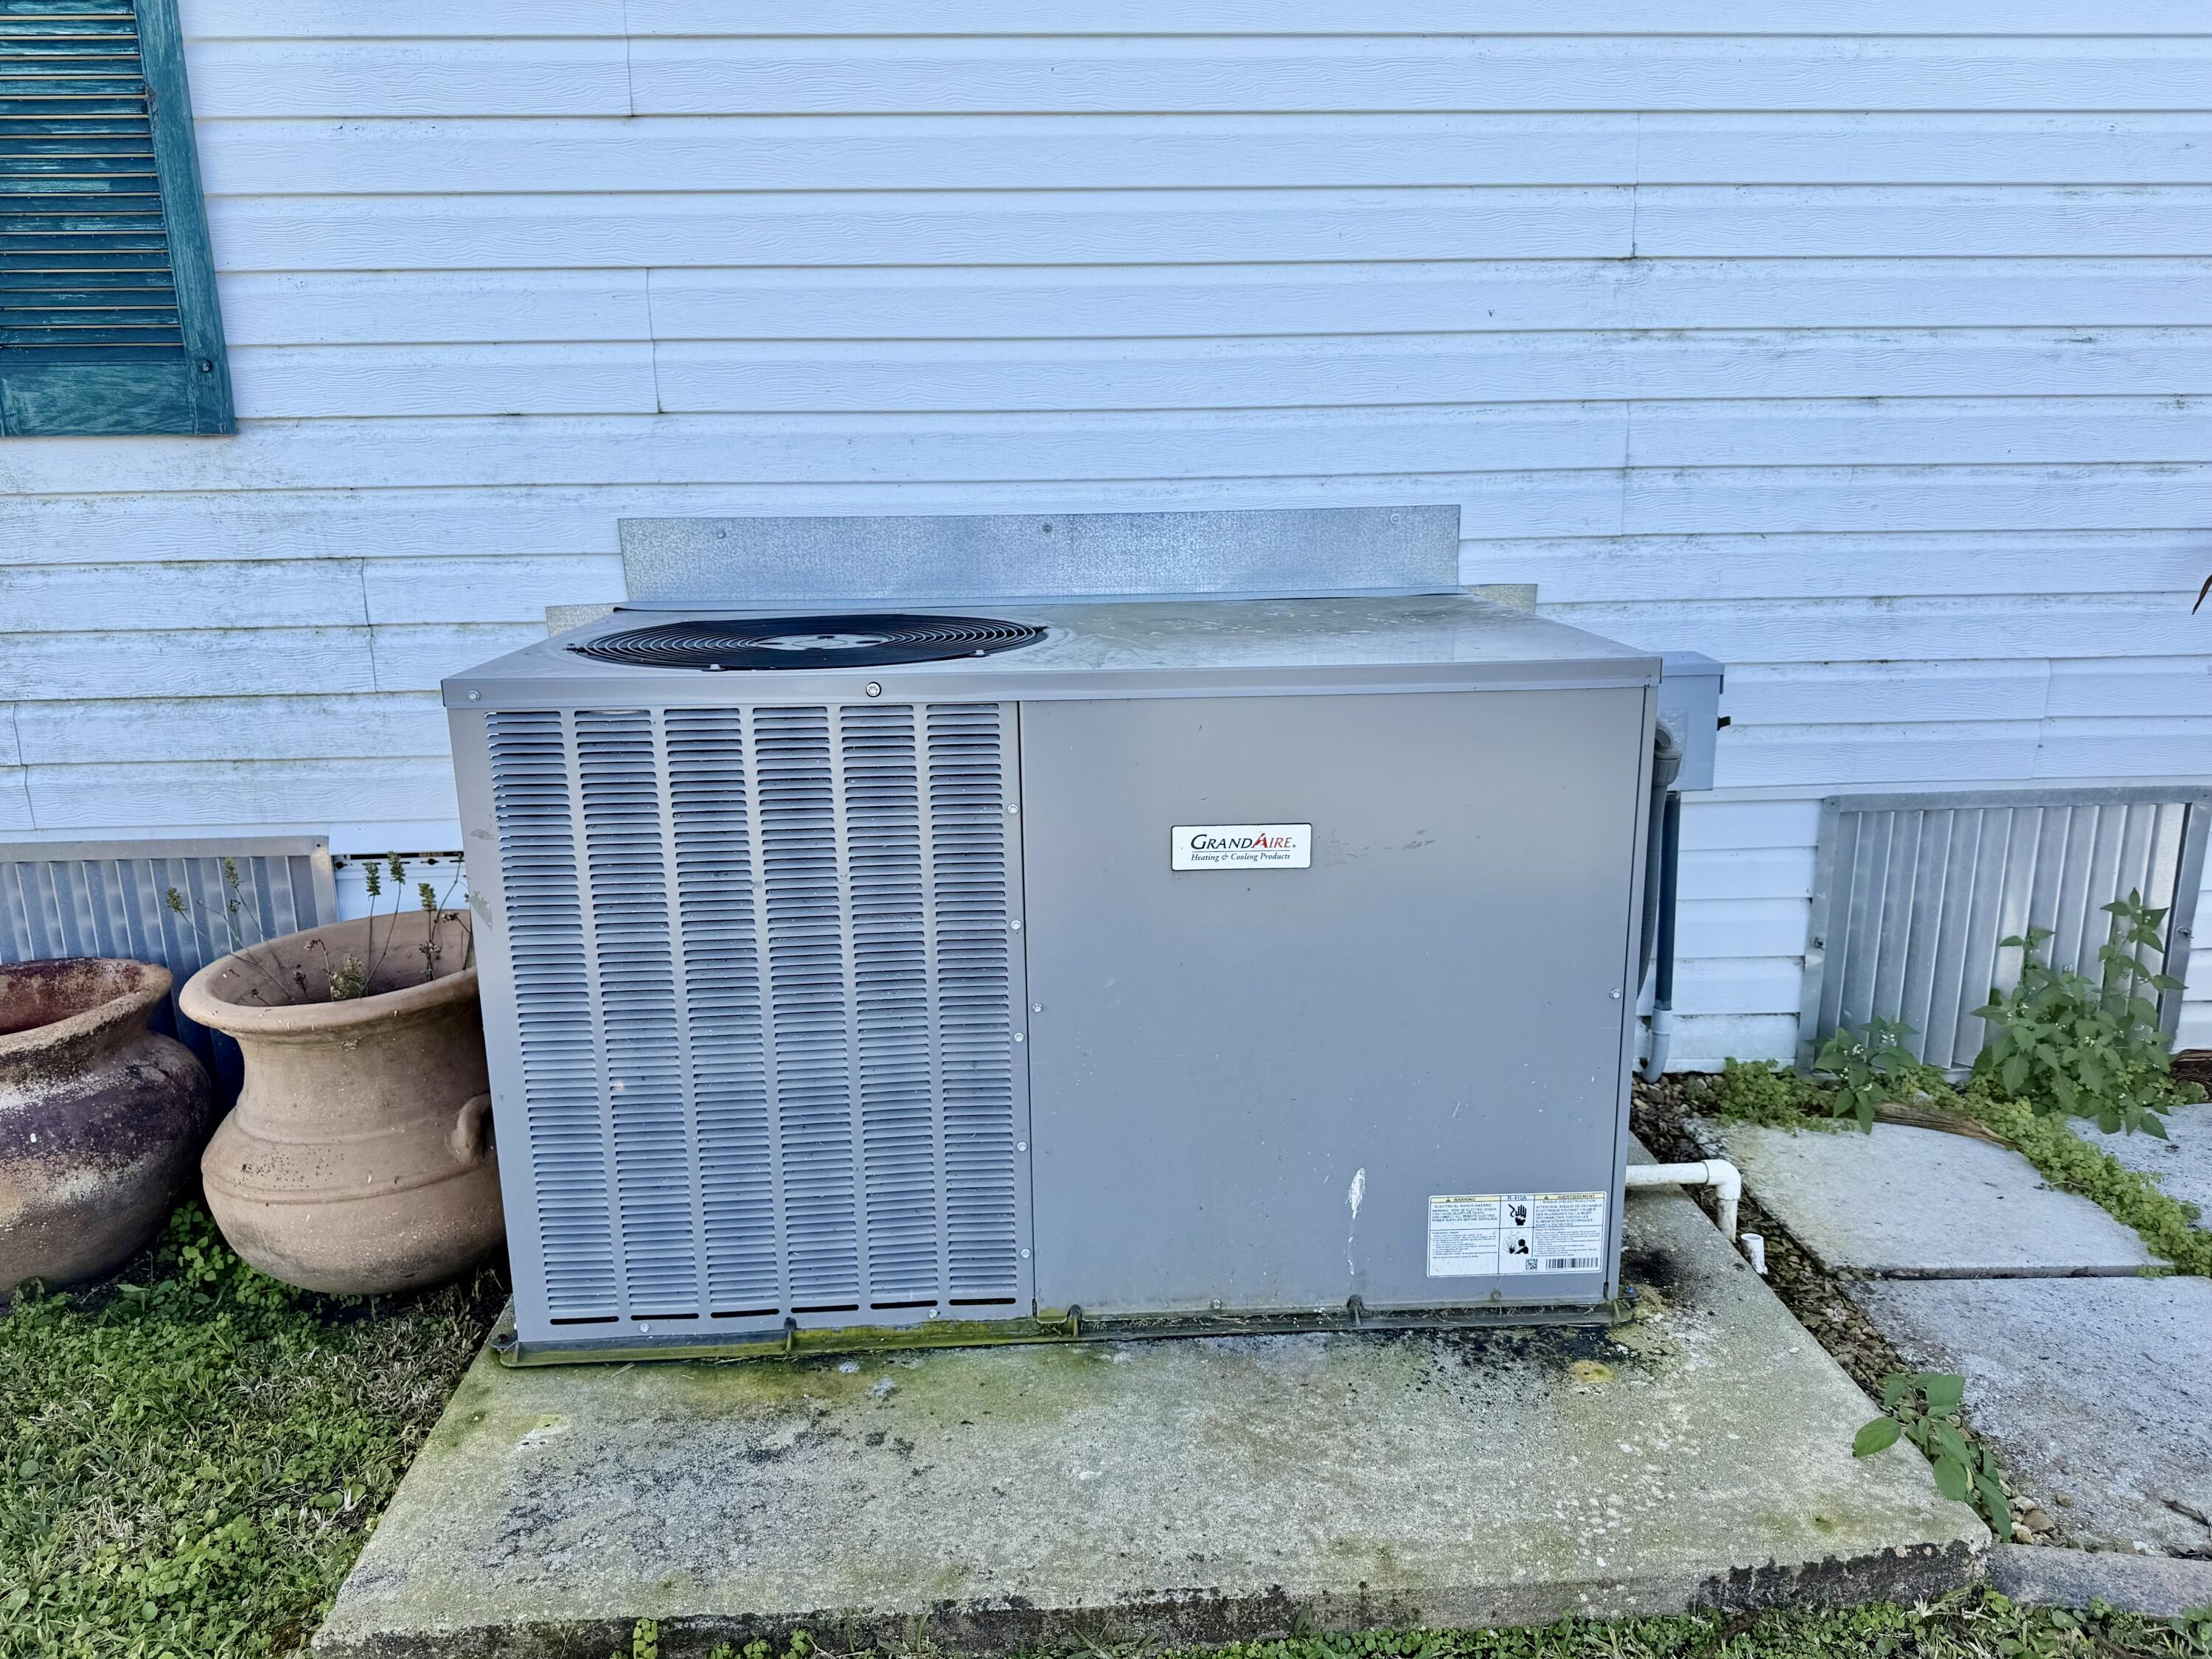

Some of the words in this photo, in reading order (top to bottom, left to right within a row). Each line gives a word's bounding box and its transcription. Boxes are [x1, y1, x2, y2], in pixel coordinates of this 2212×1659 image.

[1191, 853, 1219, 863] Heating
[1221, 852, 1228, 860] &
[1231, 852, 1258, 862] Cooling
[1260, 852, 1290, 860] Products
